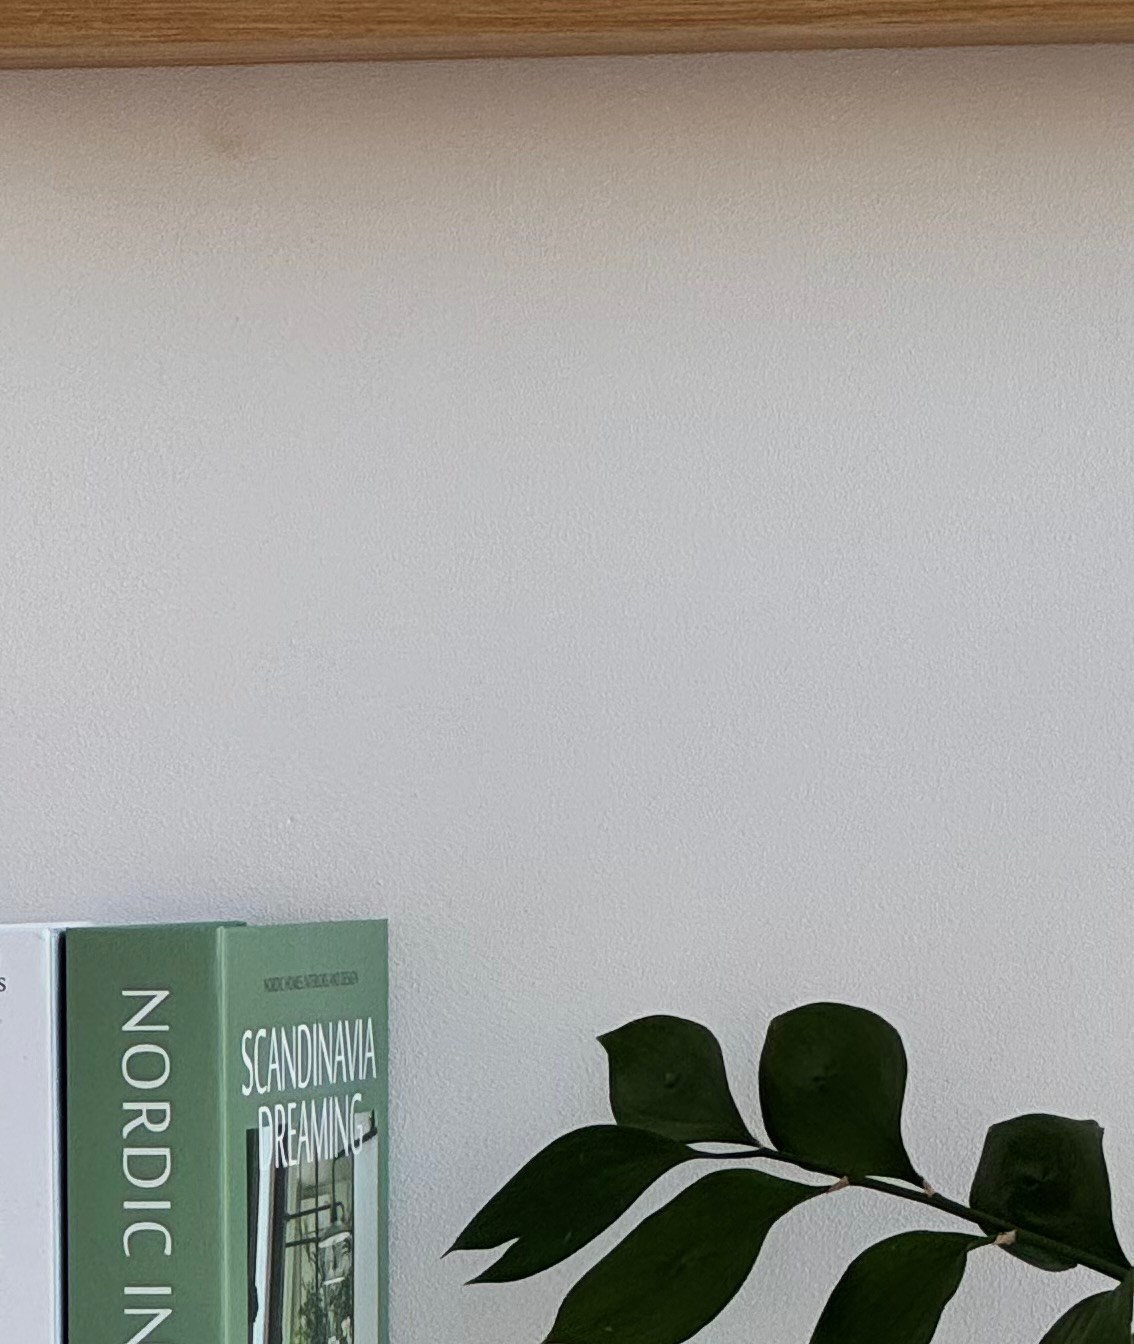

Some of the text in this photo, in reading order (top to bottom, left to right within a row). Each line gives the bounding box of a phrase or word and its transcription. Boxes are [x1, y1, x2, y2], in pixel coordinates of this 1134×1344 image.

[241, 1017, 377, 1096] SCANDINAVIA
[121, 989, 172, 1257] NORDIC
[258, 1092, 363, 1170] DREAMING
